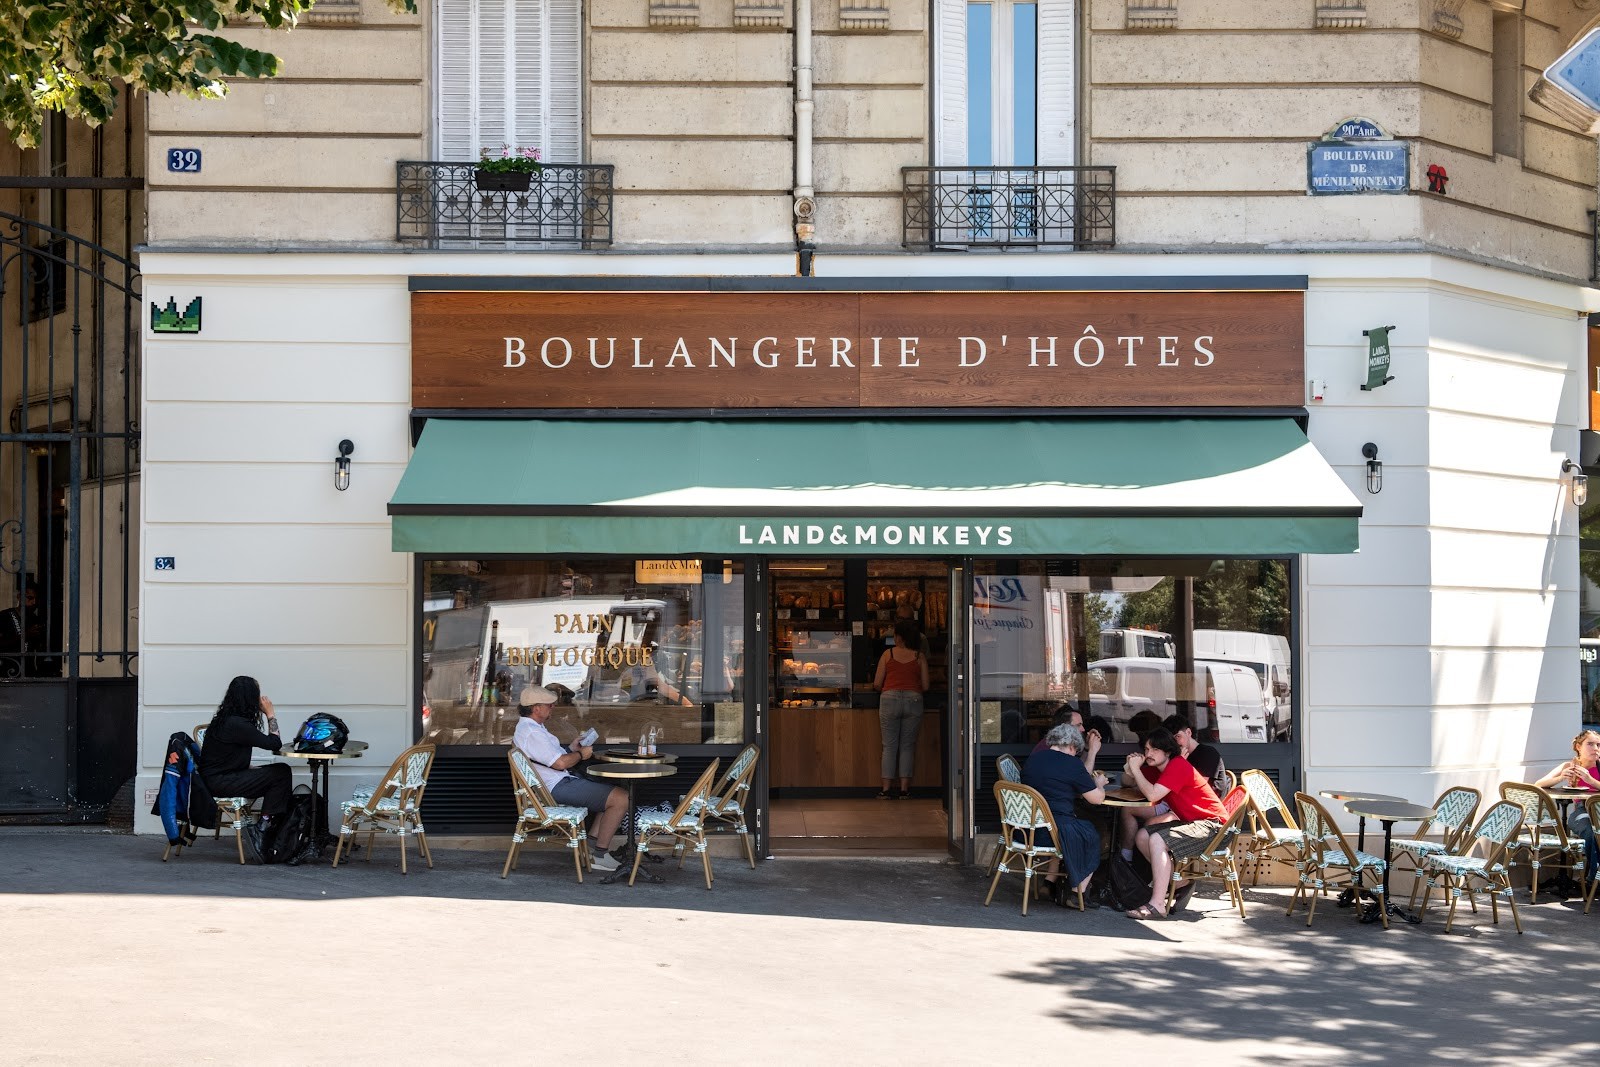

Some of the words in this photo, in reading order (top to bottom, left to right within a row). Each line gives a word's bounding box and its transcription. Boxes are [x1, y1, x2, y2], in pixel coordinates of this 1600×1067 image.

[172, 150, 198, 170] 32
[1323, 150, 1394, 161] BOULEVARD
[1350, 164, 1367, 173] DE
[503, 336, 921, 369] BOULANGERIE
[957, 324, 1215, 367] D'HÔTES
[738, 524, 1013, 546] LAND&MONKEYS
[156, 558, 173, 570] 32
[553, 613, 613, 634] PAIN
[506, 646, 654, 669] BIOLOGIQUE
